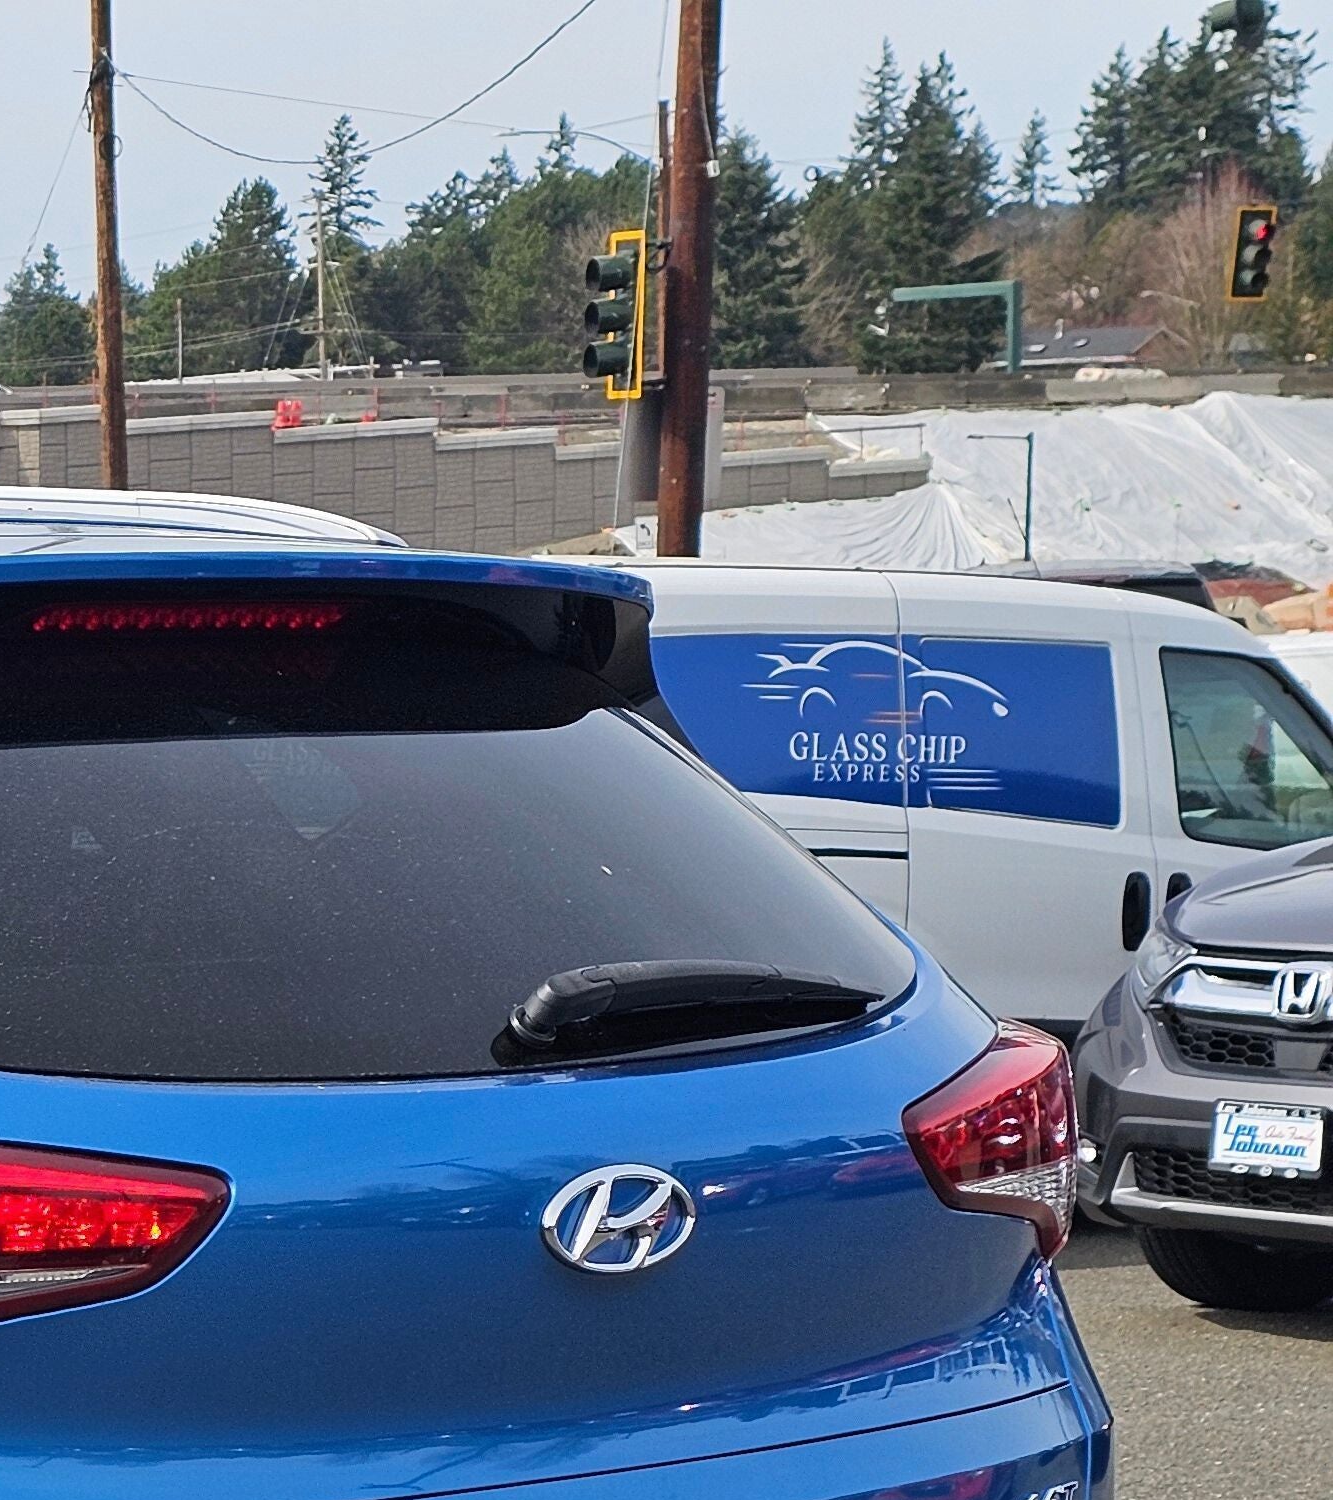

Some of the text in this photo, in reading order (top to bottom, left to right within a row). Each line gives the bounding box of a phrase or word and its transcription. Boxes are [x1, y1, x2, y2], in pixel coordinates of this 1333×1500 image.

[789, 731, 967, 764] GLASS CHIP
[813, 762, 921, 783] EXPRESS
[1223, 1114, 1259, 1136] Lee
[1222, 1136, 1307, 1157] Johnson
